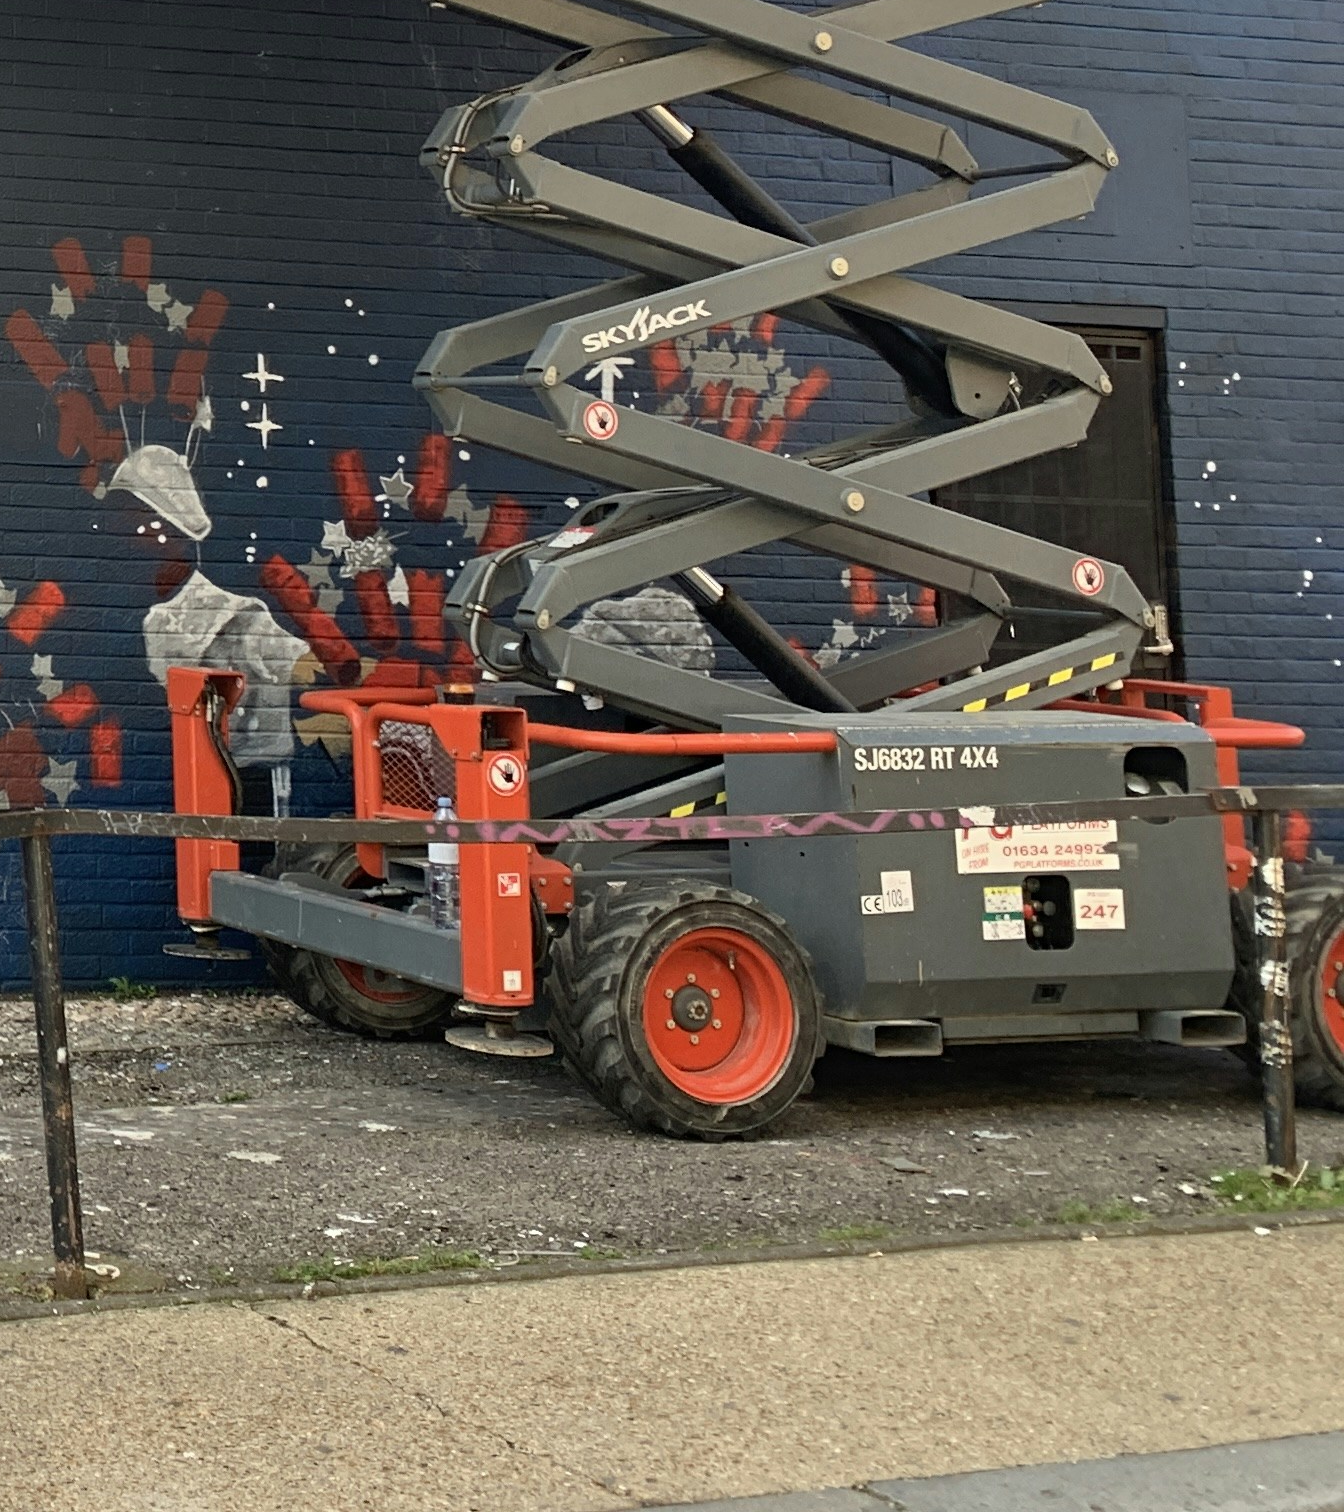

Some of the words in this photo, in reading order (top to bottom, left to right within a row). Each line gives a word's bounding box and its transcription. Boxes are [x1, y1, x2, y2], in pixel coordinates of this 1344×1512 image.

[581, 299, 713, 353] SKYJACK
[854, 747, 925, 771] SJ6832
[930, 747, 956, 770] RT
[960, 746, 1000, 769] 4X4
[1002, 845, 1049, 856] 01634
[863, 896, 882, 912] CE
[1080, 904, 1119, 919] 247
